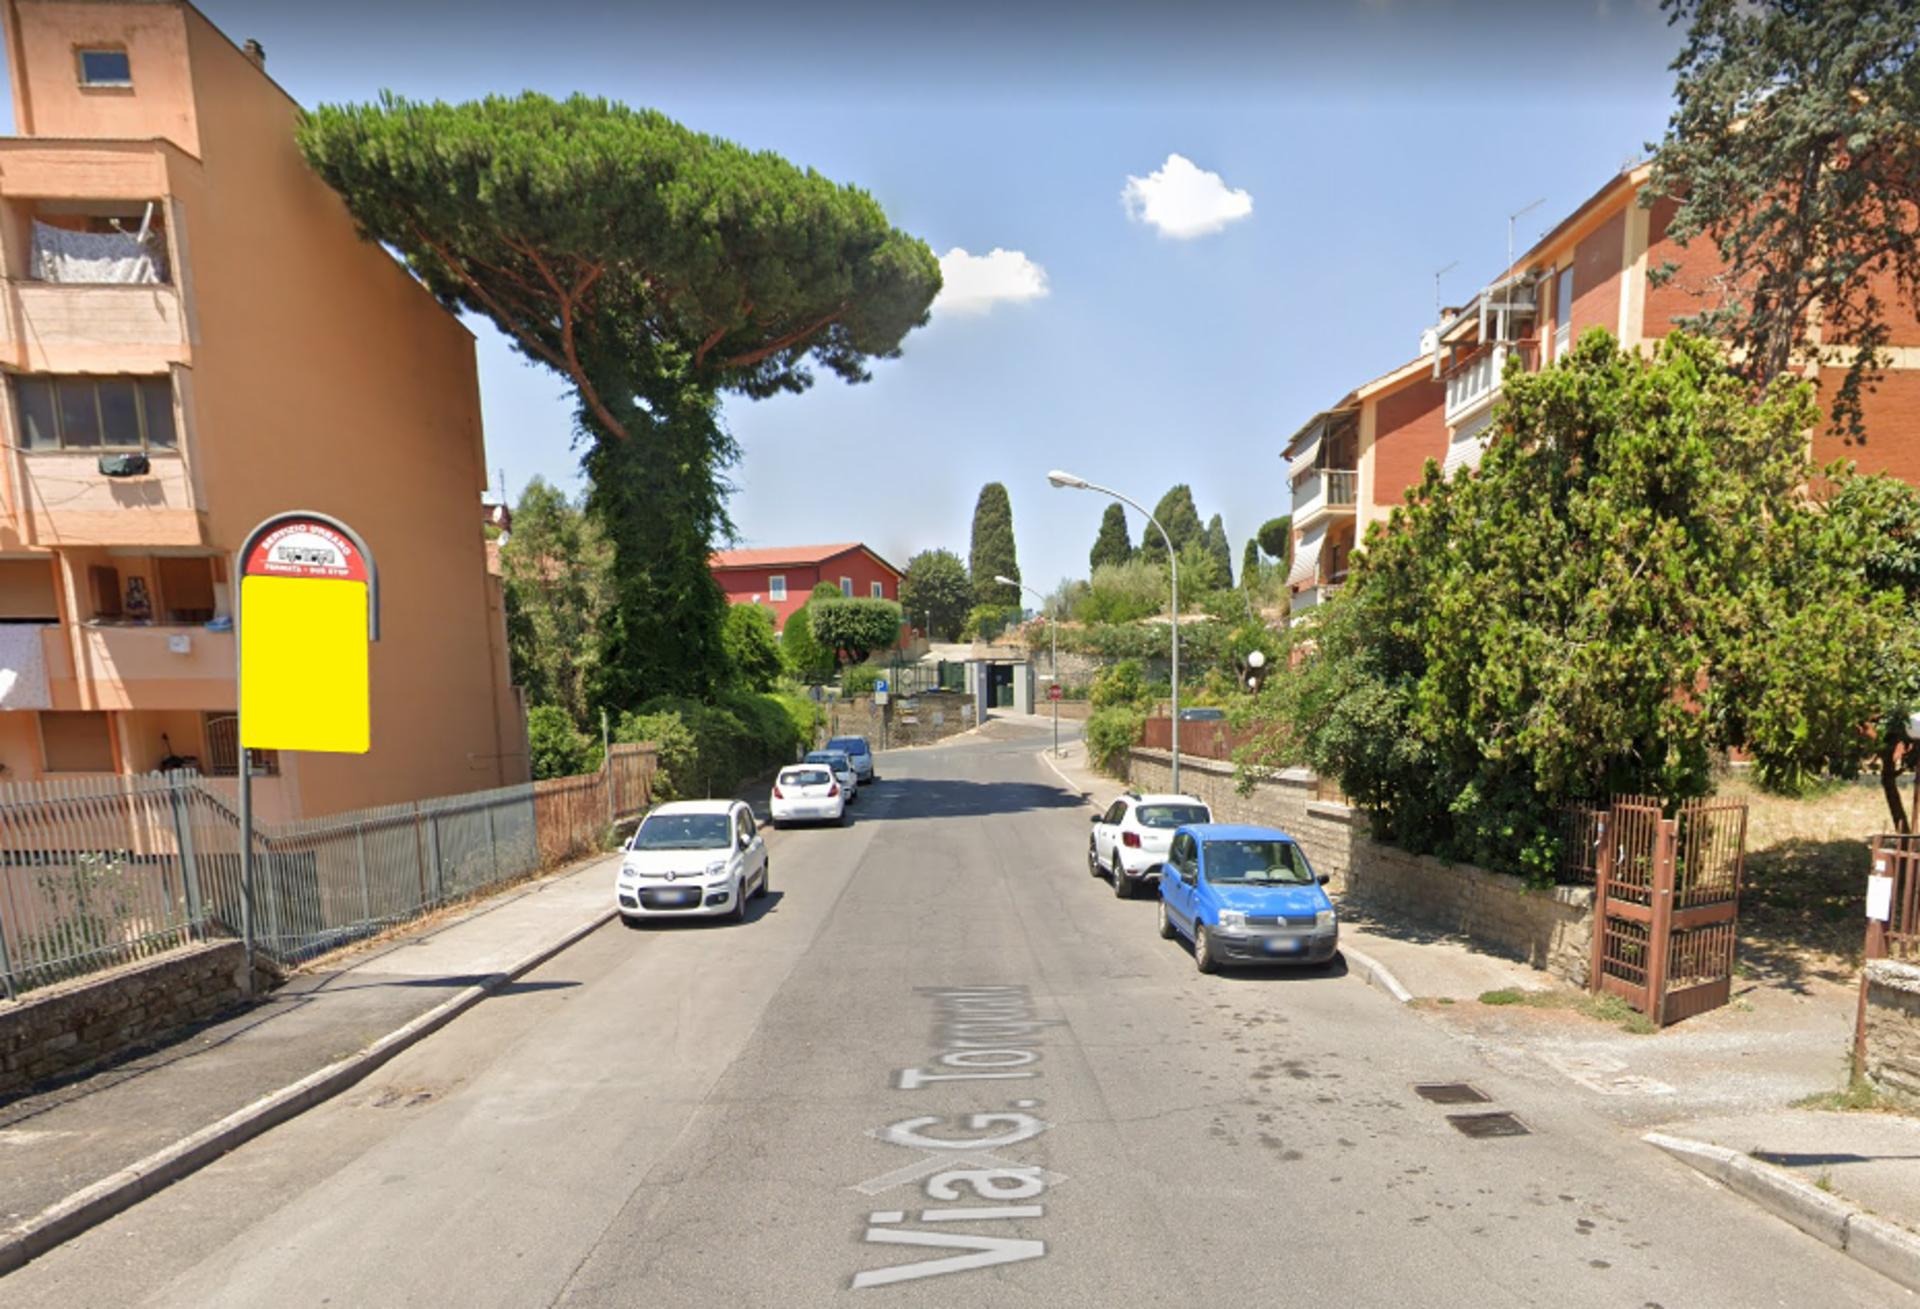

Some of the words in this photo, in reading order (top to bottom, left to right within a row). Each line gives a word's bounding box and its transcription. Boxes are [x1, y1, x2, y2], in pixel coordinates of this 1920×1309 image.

[261, 524, 307, 550] SERVIZIO
[310, 524, 352, 556] URBANO
[310, 566, 326, 574] BUS
[328, 567, 349, 576] STOP
